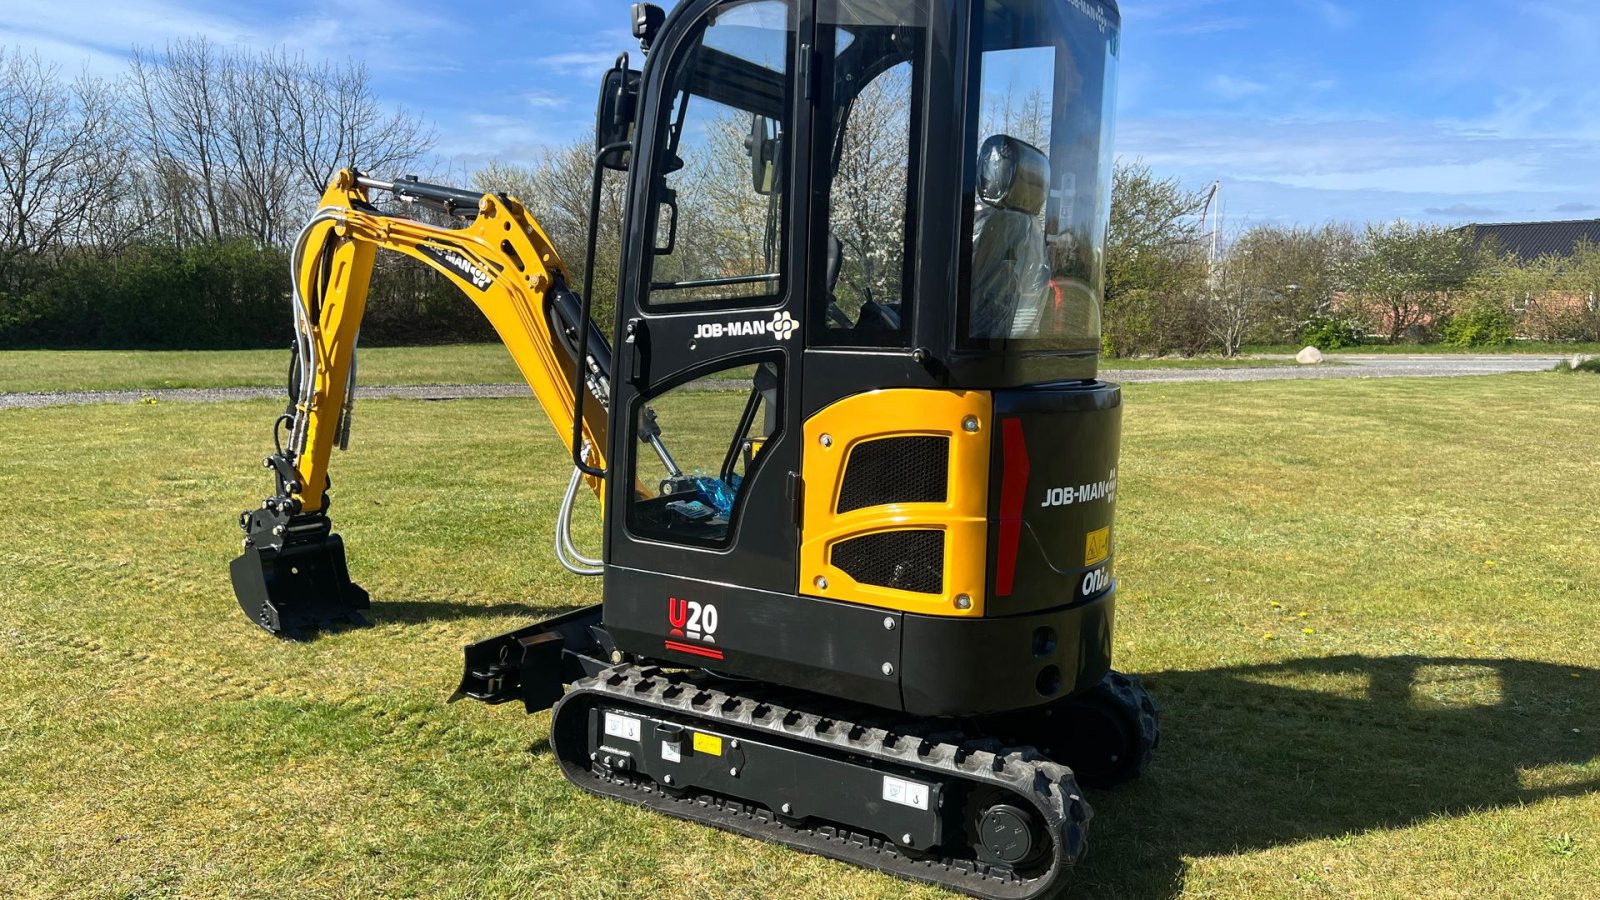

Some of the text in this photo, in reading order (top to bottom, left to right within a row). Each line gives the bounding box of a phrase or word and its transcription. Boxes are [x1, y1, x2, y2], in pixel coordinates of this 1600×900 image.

[1067, 0, 1096, 21] B-MAN
[694, 320, 765, 339] JOB-MAN
[1041, 480, 1105, 507] JOB-MAN
[669, 597, 718, 634] U20
